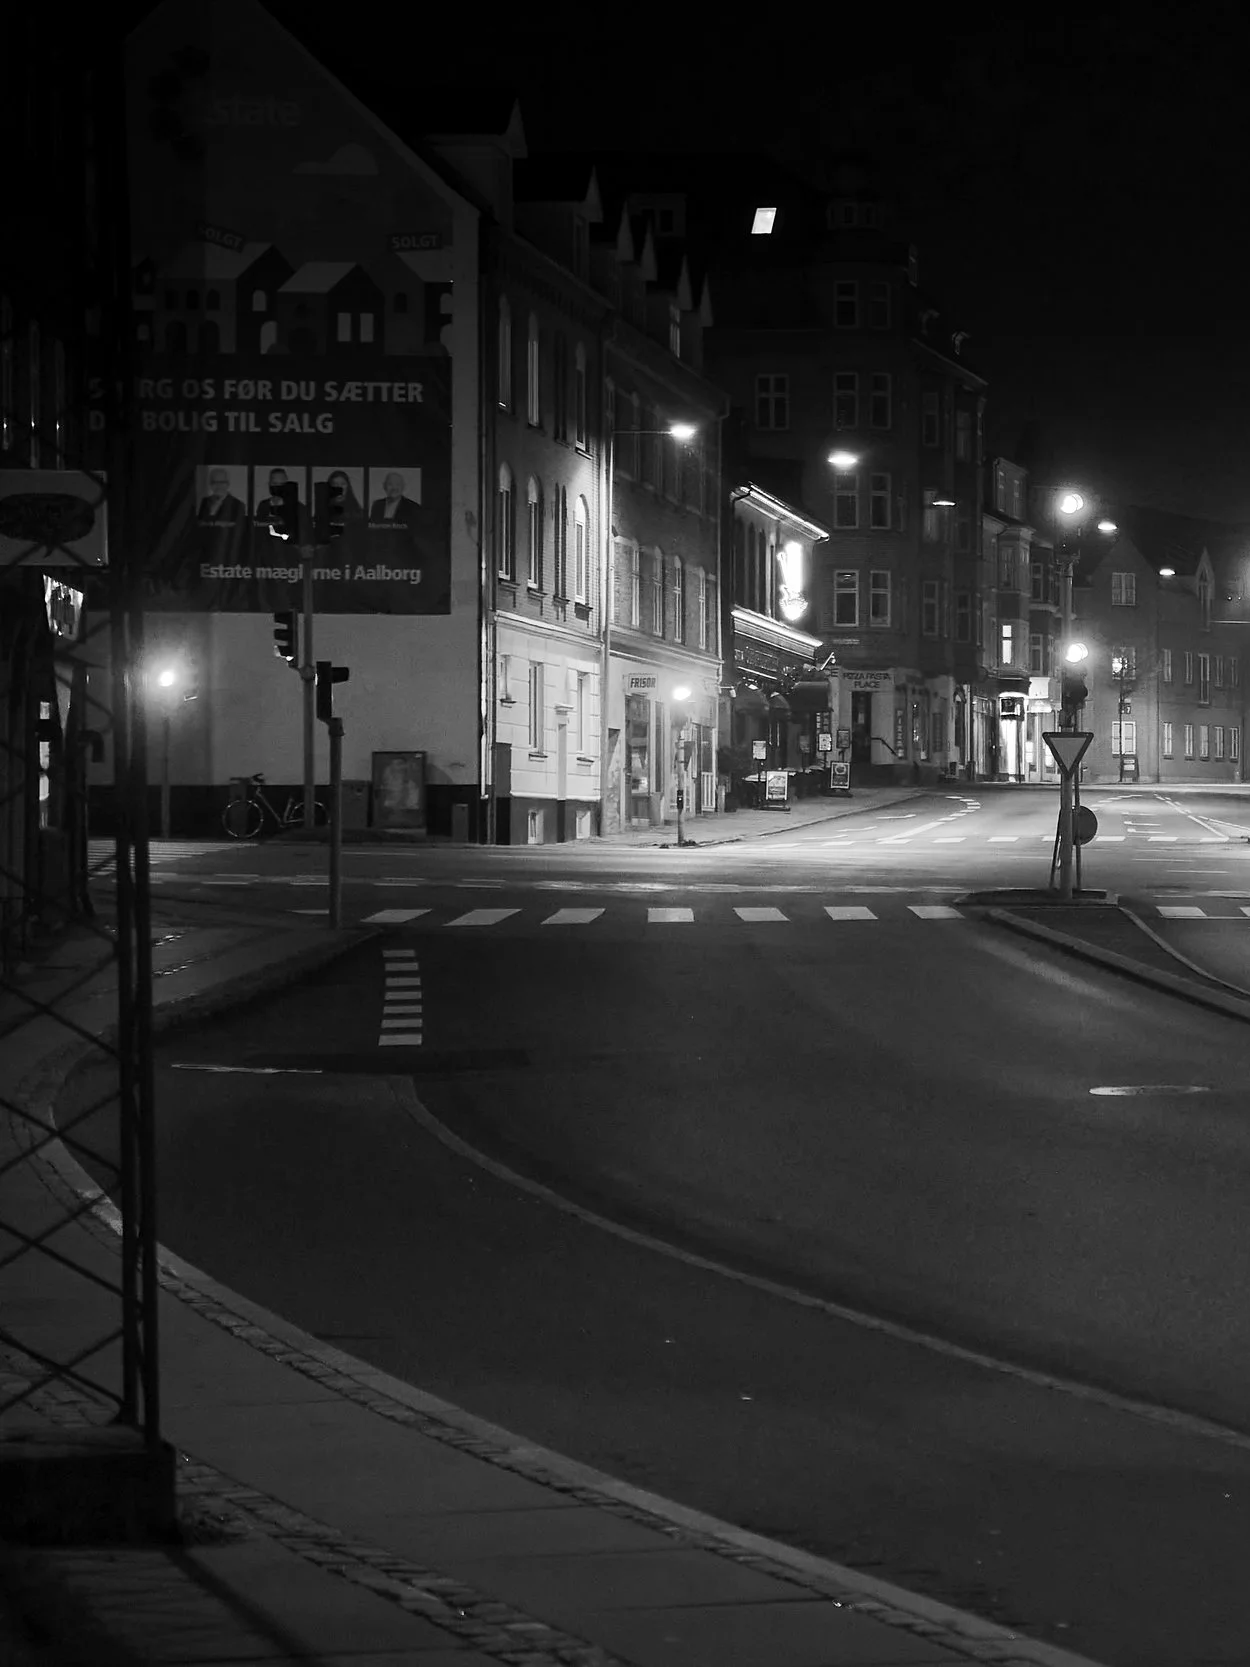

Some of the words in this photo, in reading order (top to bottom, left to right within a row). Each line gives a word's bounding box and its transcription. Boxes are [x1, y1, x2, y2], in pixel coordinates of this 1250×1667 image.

[202, 92, 301, 127] state
[391, 234, 438, 249] SOLGT
[182, 378, 216, 400] OS
[223, 379, 273, 401] FØR
[280, 380, 317, 402] DU
[324, 381, 424, 403] SÆTTER
[142, 410, 219, 433] BOLIG
[224, 411, 262, 433] TIL
[268, 412, 334, 434] SALG
[201, 563, 253, 580] Estate
[255, 563, 341, 584] mæglrne
[354, 564, 422, 585] Aalborg
